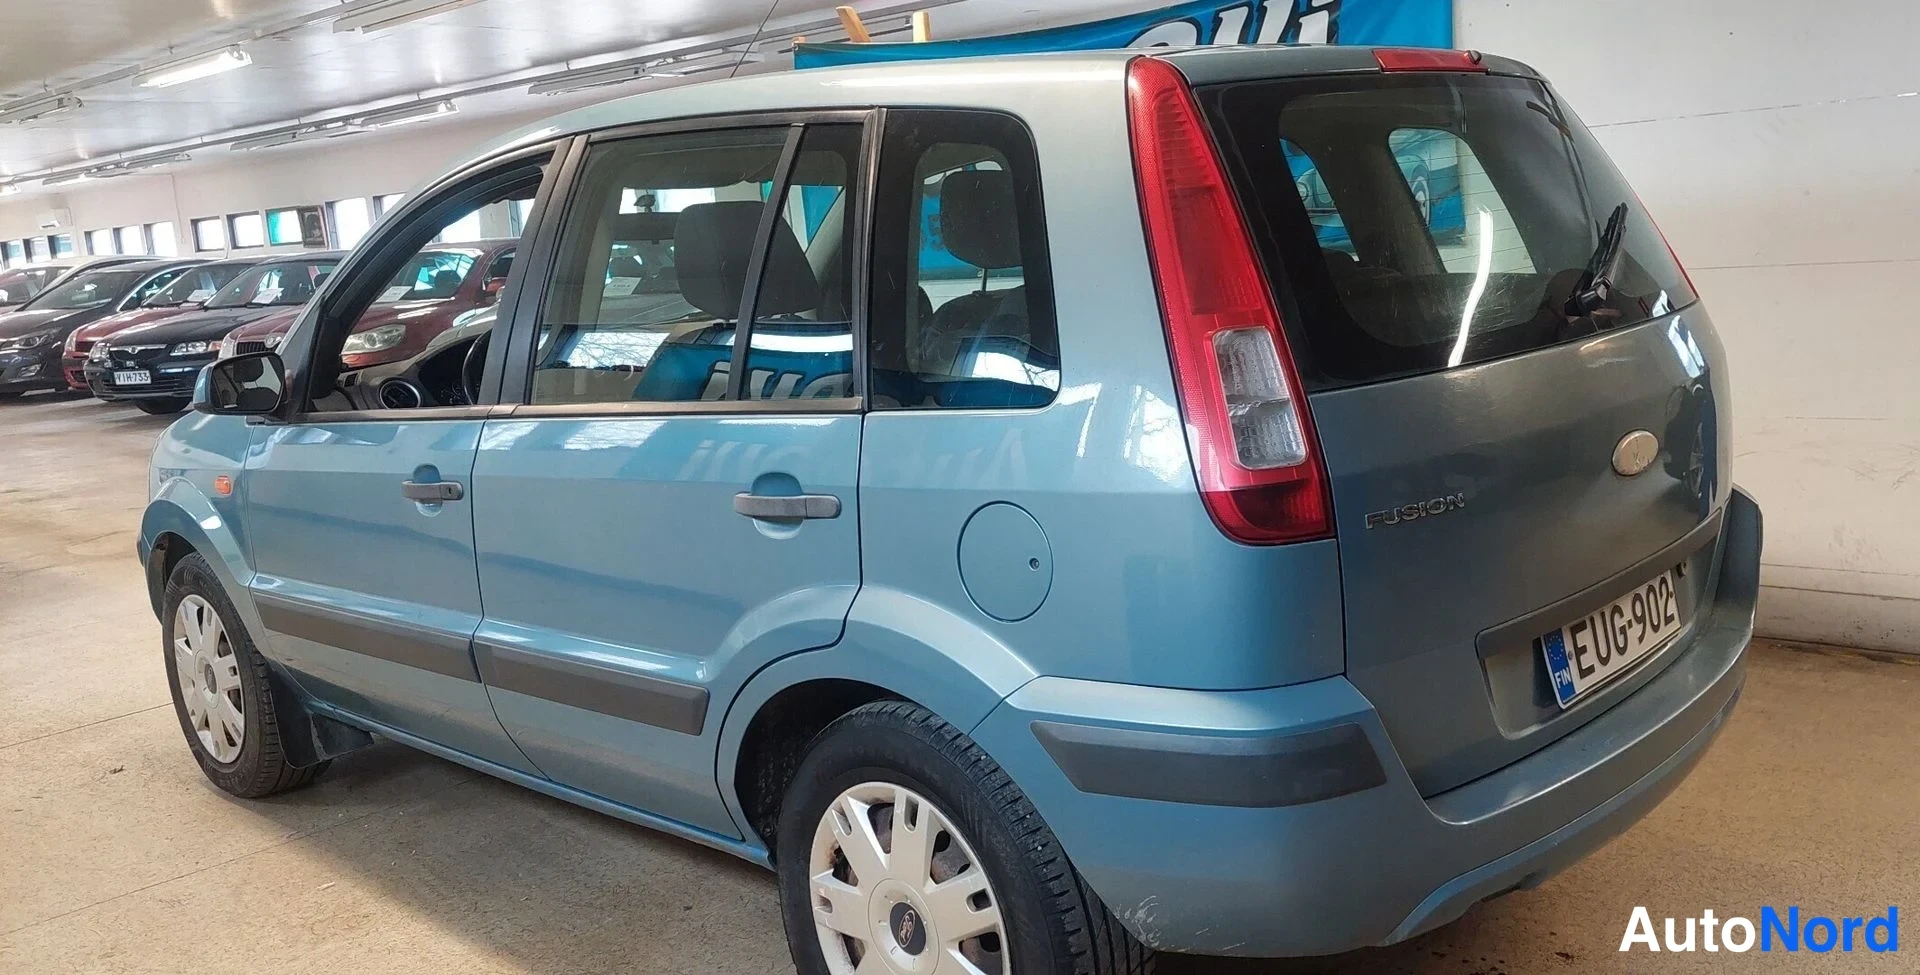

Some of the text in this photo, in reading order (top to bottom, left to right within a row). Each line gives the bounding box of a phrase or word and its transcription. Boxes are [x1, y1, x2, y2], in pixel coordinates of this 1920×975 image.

[1364, 492, 1465, 530] FUSION
[1569, 576, 1675, 680] EUG-902
[1554, 667, 1572, 689] FIN
